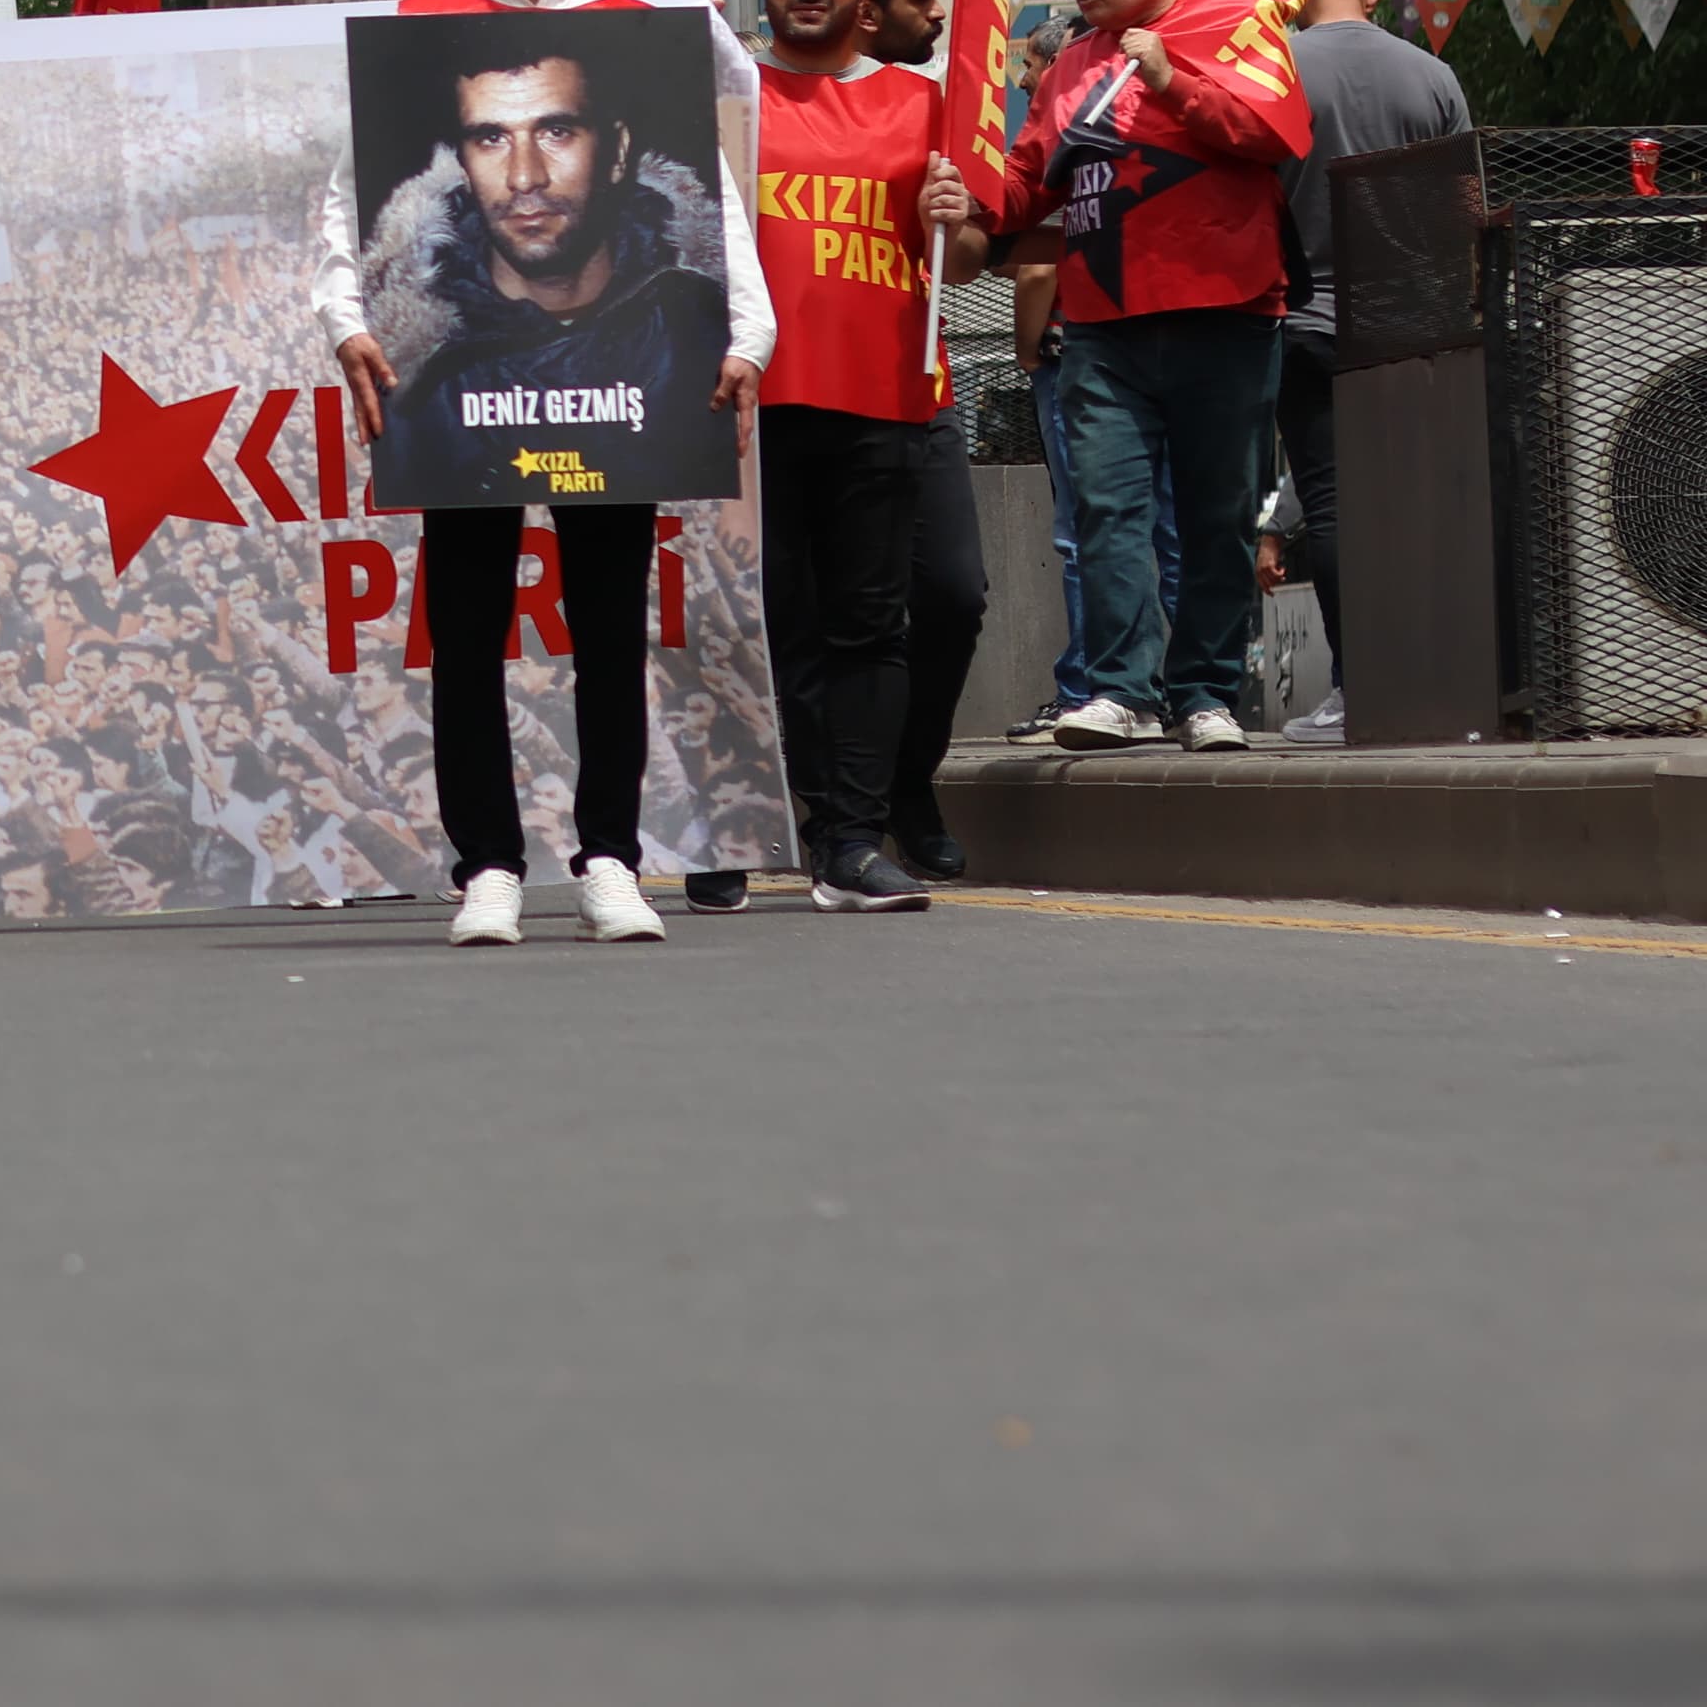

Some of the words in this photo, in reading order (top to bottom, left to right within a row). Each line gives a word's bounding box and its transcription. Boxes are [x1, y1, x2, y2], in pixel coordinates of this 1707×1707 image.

[462, 384, 541, 428] DENİZ
[544, 381, 646, 433] GEZMİŞ
[538, 450, 586, 472] KIZIL
[550, 472, 607, 494] PARTİ
